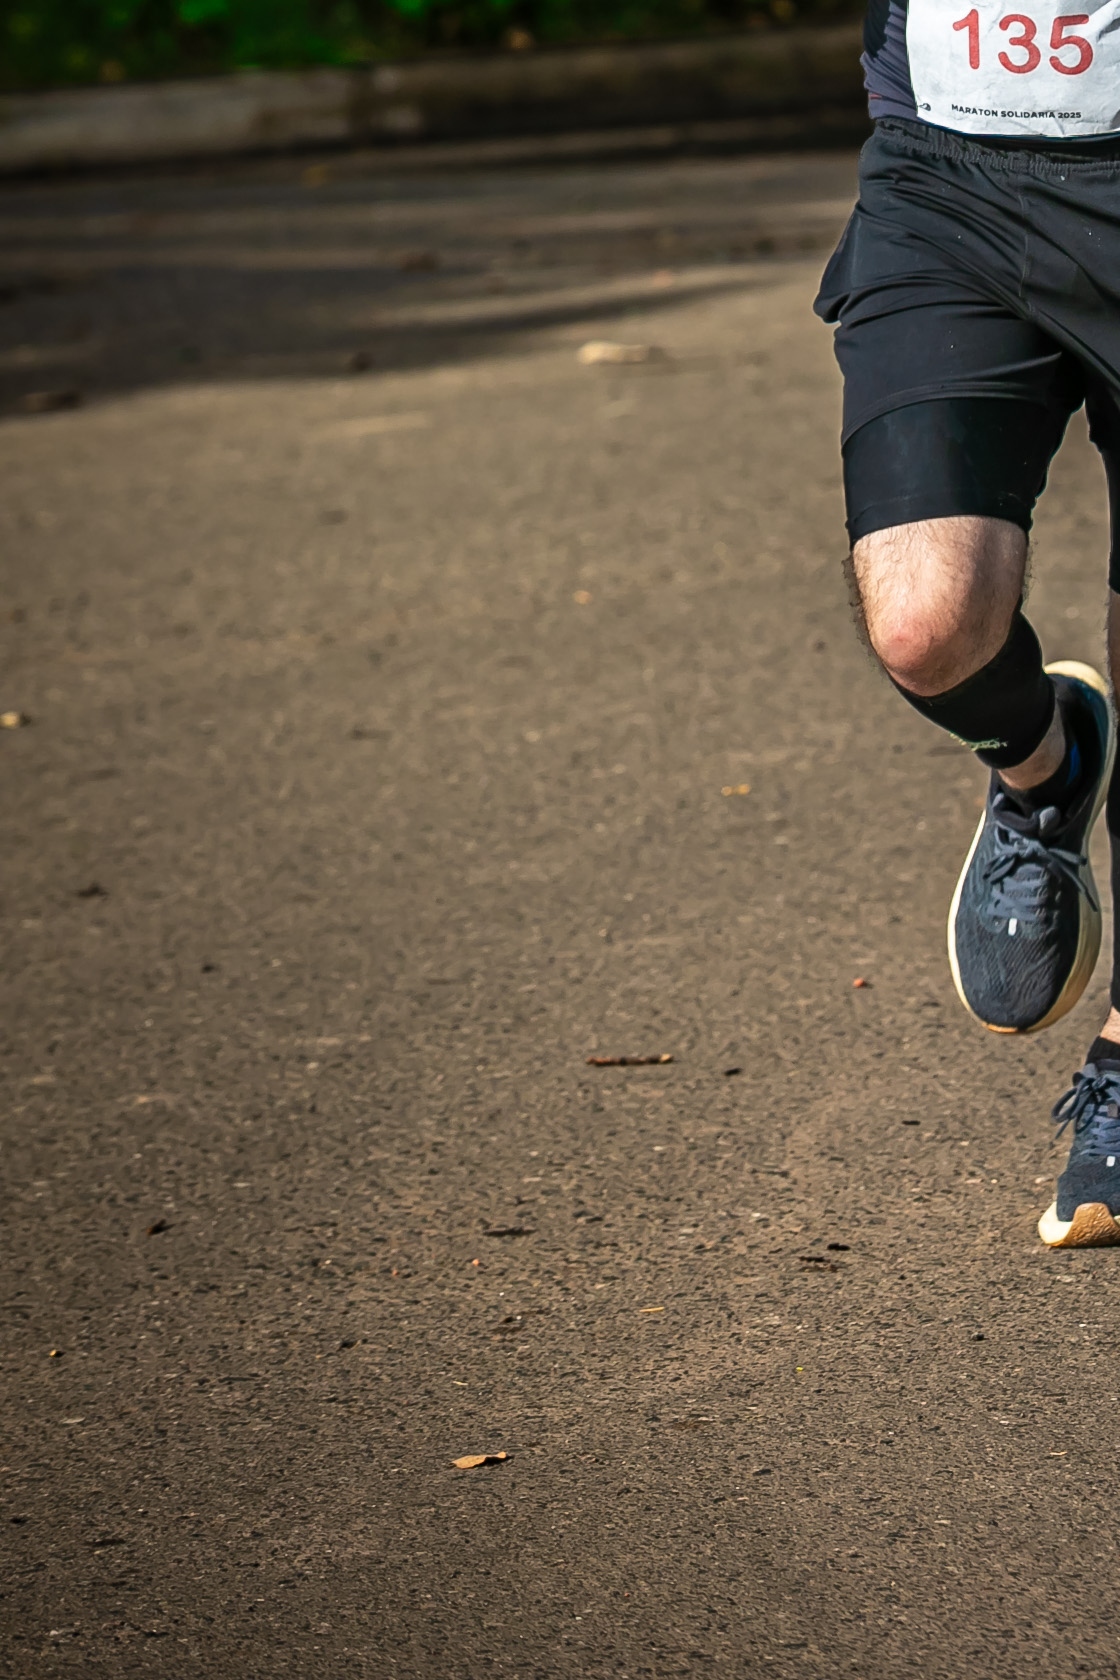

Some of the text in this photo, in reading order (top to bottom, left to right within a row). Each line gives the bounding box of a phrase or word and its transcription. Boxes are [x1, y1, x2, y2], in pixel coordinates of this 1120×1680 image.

[952, 8, 1094, 76] 135
[951, 104, 1082, 119] MARATON SOLIDARIA 2025
